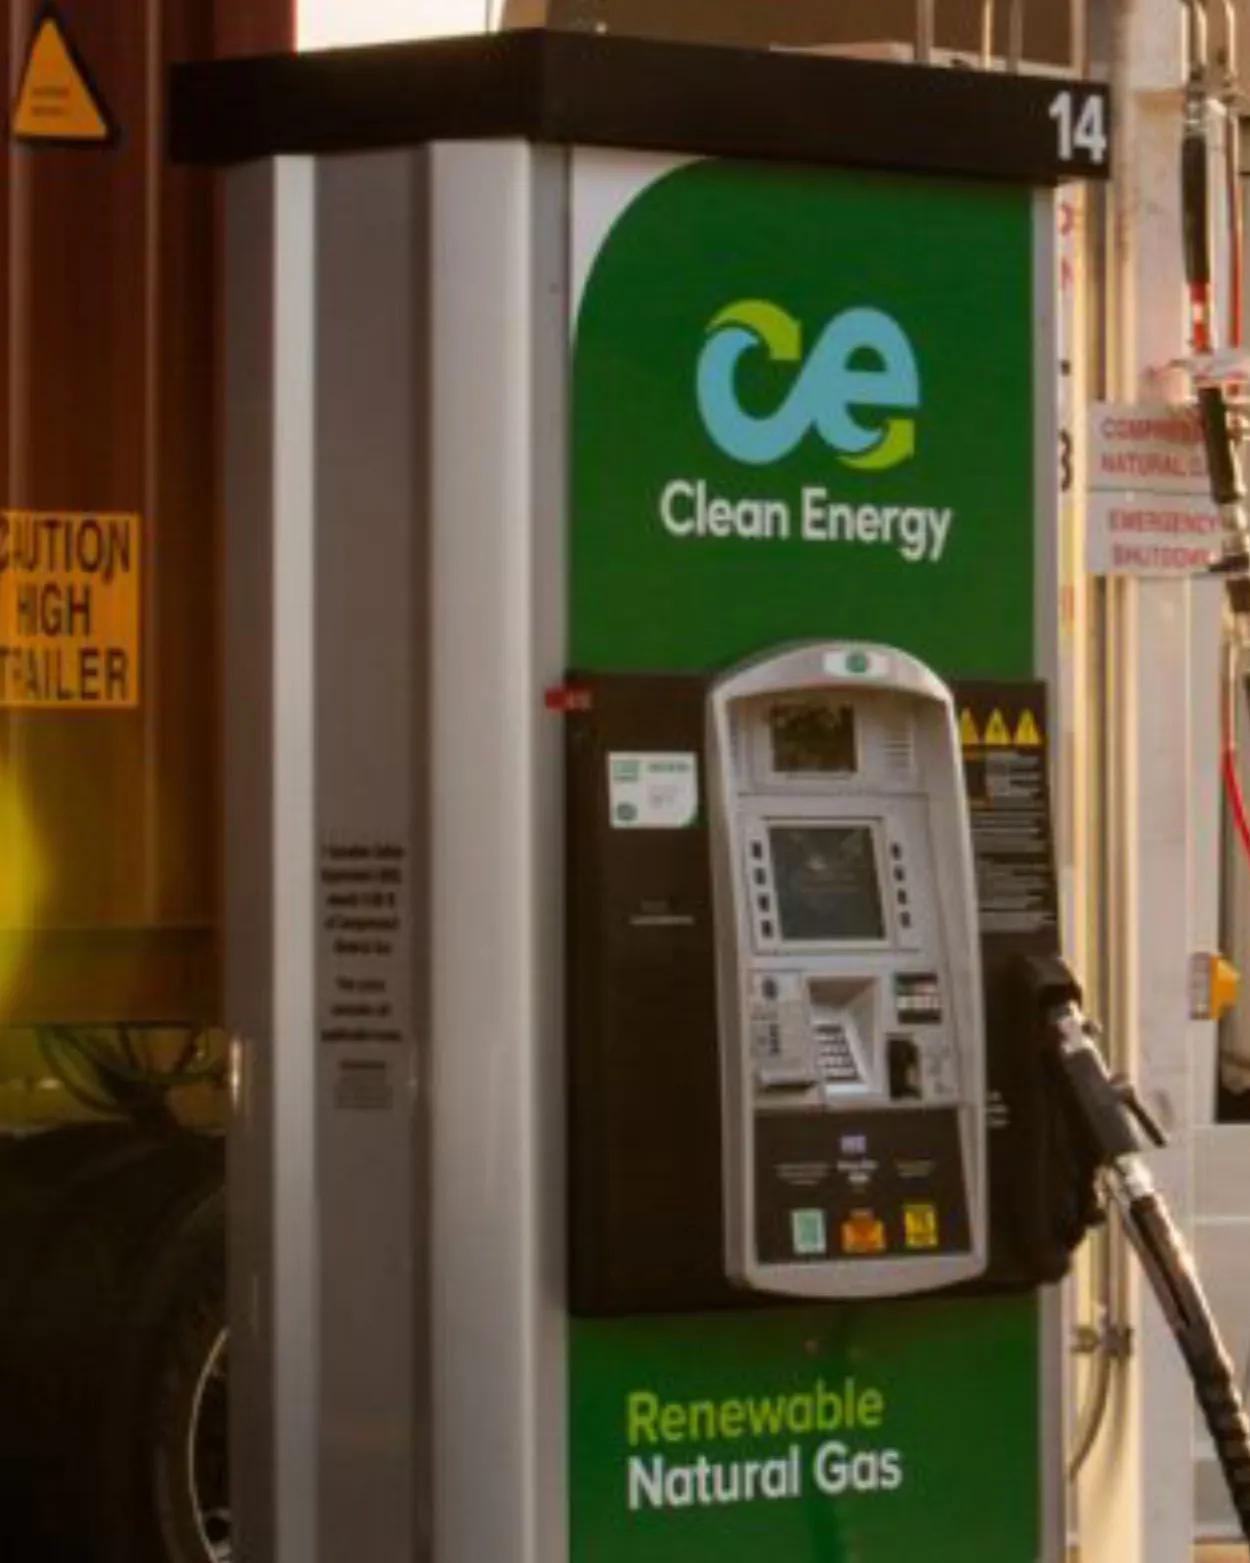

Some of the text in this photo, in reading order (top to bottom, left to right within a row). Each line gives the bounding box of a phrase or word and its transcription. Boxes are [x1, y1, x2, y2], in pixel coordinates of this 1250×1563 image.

[1048, 91, 1106, 164] 14
[1101, 453, 1186, 477] NATURAL
[660, 479, 952, 562] Clean Energy
[1109, 509, 1218, 535] EMERGENCY
[17, 580, 91, 637] HIGH
[626, 1376, 884, 1446] Renewable
[627, 1439, 903, 1511] Natural Gas
